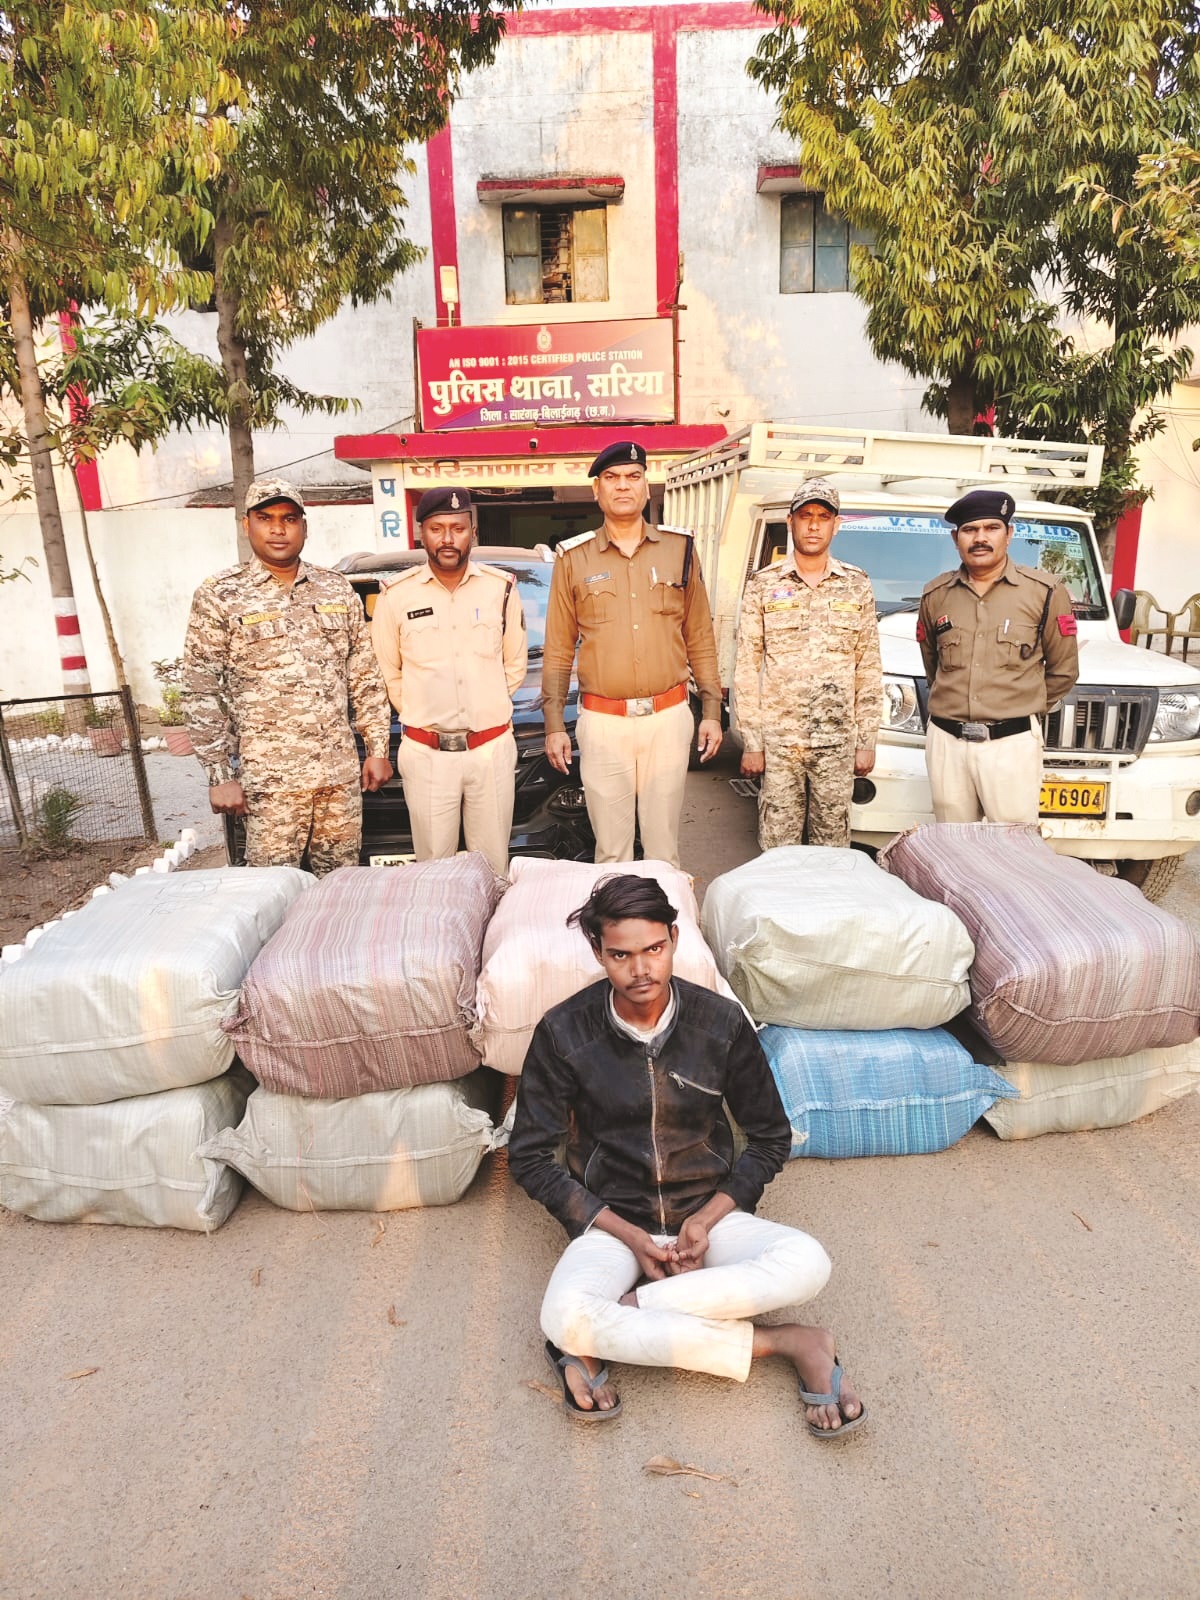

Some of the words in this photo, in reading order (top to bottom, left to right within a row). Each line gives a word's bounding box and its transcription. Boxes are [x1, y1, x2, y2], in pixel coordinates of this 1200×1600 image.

[449, 358, 460, 369] AN
[462, 357, 476, 368] ISO
[479, 356, 499, 366] 9001
[507, 355, 528, 366] 2015
[530, 353, 573, 365] CERTIFIED
[576, 352, 606, 362] POLICE
[608, 350, 642, 361] STATION
[428, 369, 505, 415] पुलिस
[510, 375, 581, 402] थाना,
[586, 362, 664, 397] सरिया
[480, 408, 502, 421] जिला
[410, 459, 556, 479] परित्राणाय
